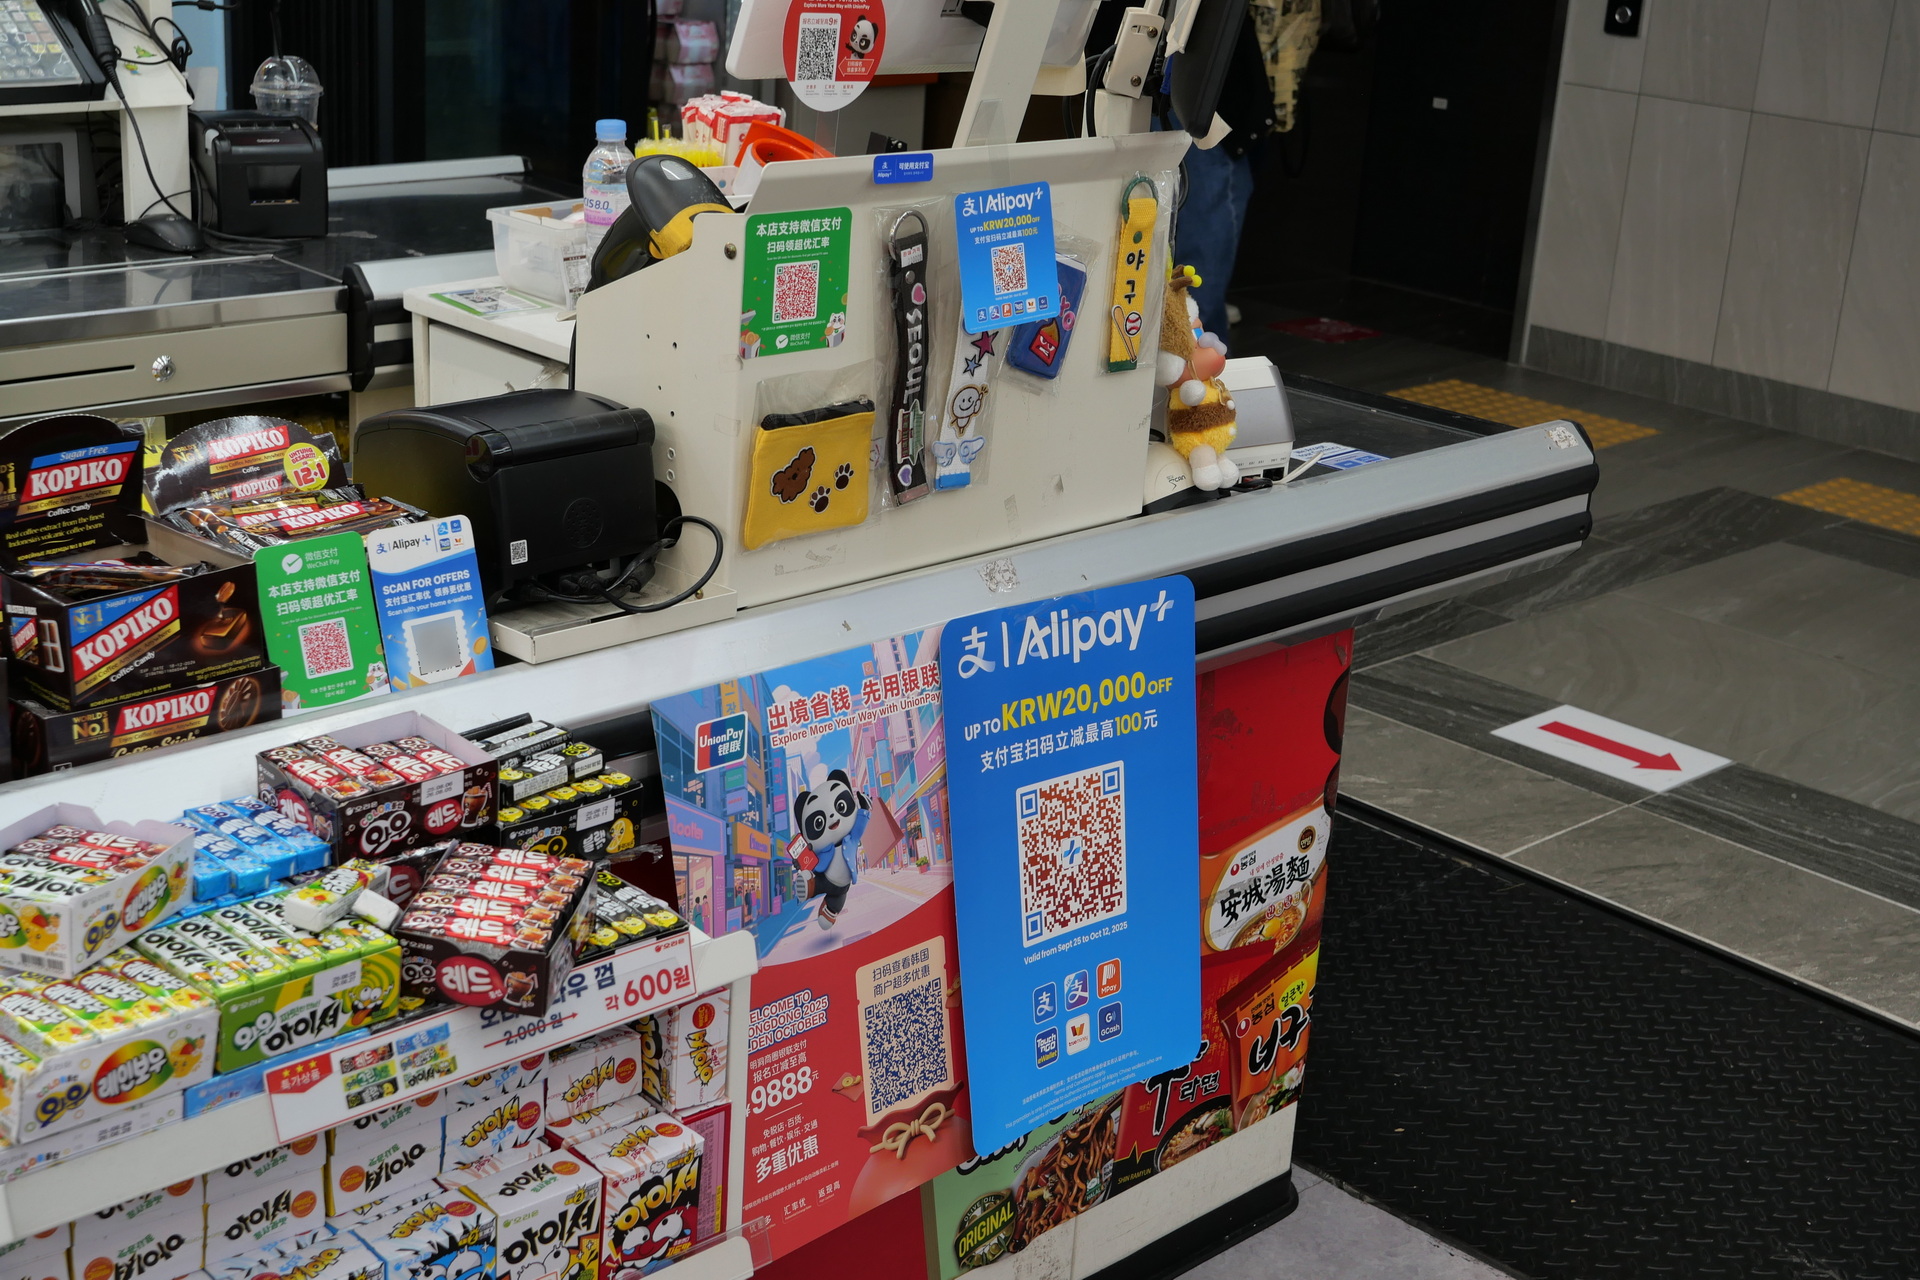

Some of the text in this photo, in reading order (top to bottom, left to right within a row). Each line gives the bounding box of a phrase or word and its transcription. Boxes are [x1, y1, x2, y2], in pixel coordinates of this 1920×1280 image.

[898, 161, 930, 170] 可使用支付宝
[756, 216, 842, 237] 本店支持微信支付
[983, 214, 1033, 231] KRW20,000
[766, 236, 830, 254] 扫码领超优汇率
[974, 228, 1039, 245] 支付宝扫码立减最高100元
[1123, 249, 1146, 304] 야구
[789, 333, 811, 342] 微信支付
[903, 308, 922, 404] SEOUL
[60, 446, 109, 461] Sugar Free
[209, 427, 285, 460] KOPIKO
[289, 447, 313, 459] UNTUNG
[30, 458, 123, 497] KOPIKO
[242, 466, 260, 474] Coffee
[47, 502, 92, 517] Coffee Candy
[5, 513, 105, 541] Real coffee extract from the finest
[8, 522, 103, 549] Indonesia's volcanic coffee beans
[304, 547, 338, 561] 微信支付
[306, 558, 340, 569] WeChat Pay
[267, 569, 361, 598] 本店支持微信支付
[382, 569, 470, 595] SCAN FOR OFFERS
[385, 582, 472, 608] 支付宝汇率优 领券更优惠
[105, 594, 144, 610] Sugar Free
[276, 589, 359, 616] 扫码领超优汇率
[387, 594, 473, 617] Scan with your home e-wallets
[75, 597, 173, 671] KOPIKO
[110, 664, 134, 683] Coffee
[133, 650, 156, 669] Candy
[767, 661, 940, 731] 出境省钱 先用银联
[964, 671, 1173, 741] UP TO KRW20,000 OFF
[72, 710, 109, 722] WORLD'S
[123, 691, 210, 730] KOPIKO
[771, 691, 941, 747] Explore More Your Way with UnionPay
[72, 717, 111, 740] No.1
[700, 728, 744, 748] UnionPay
[980, 709, 1158, 773] 支付宝扫码立减最高100元
[718, 740, 742, 756] 银联
[583, 829, 606, 853] 블랙
[1240, 856, 1257, 871] 농심
[125, 873, 168, 925] 레인보우
[1220, 855, 1313, 928] 安城湯麵
[450, 918, 505, 938] 레드
[663, 938, 685, 949] 오리온
[1024, 953, 1041, 965] Valid
[1041, 948, 1057, 961] from
[1057, 940, 1072, 956] Sept
[1073, 938, 1082, 948] 25
[1089, 930, 1102, 943] Oct
[1102, 927, 1111, 938] 12,
[1111, 921, 1128, 935] 2025
[594, 961, 616, 991] 껌
[872, 947, 930, 982] 扫码查看韩国
[441, 964, 493, 994] 레드
[605, 965, 691, 1012] 각 600원
[873, 965, 930, 998] 商户超多优惠
[1101, 984, 1117, 995] MPay
[488, 988, 503, 1000] 풍선
[749, 989, 811, 1024] ELCOME TO
[1281, 982, 1305, 1007] 얼큰한
[748, 998, 828, 1038] ONGDONG 2025
[1251, 999, 1276, 1027] 농심
[504, 1012, 564, 1046] 2,000 원
[748, 1013, 826, 1053] DEN OCTOBER
[1037, 1033, 1056, 1047] Touch
[1068, 1036, 1088, 1047] truemoney
[1100, 1024, 1120, 1037] GCash
[750, 1039, 807, 1070] 明洞商圈银联支付
[1037, 1050, 1058, 1064] eWallet
[97, 1047, 169, 1099] 레인보우
[280, 1071, 320, 1090] 특가상품
[357, 1068, 376, 1086] 그린
[408, 1067, 435, 1087] 아이셔
[494, 1065, 519, 1088] 소다맛
[561, 1055, 615, 1103] 아이셔
[753, 1052, 807, 1084] 报名立减至高
[1178, 1070, 1220, 1102] 라면
[575, 1092, 595, 1109] 자두맛
[460, 1094, 520, 1148] 아이셔
[491, 1124, 515, 1149] 소다맛
[756, 1135, 819, 1183] 多重优惠
[1118, 1167, 1152, 1185] SHIN RAMYUN
[609, 1158, 700, 1232] 아이셔
[817, 1181, 841, 1198] 返现高
[512, 1209, 538, 1225] 오리온
[783, 1197, 807, 1216] 汇率优
[963, 1195, 996, 1222] OLIVE OIL
[501, 1198, 598, 1265] 아이셔
[958, 1202, 1015, 1258] ORIGINAL
